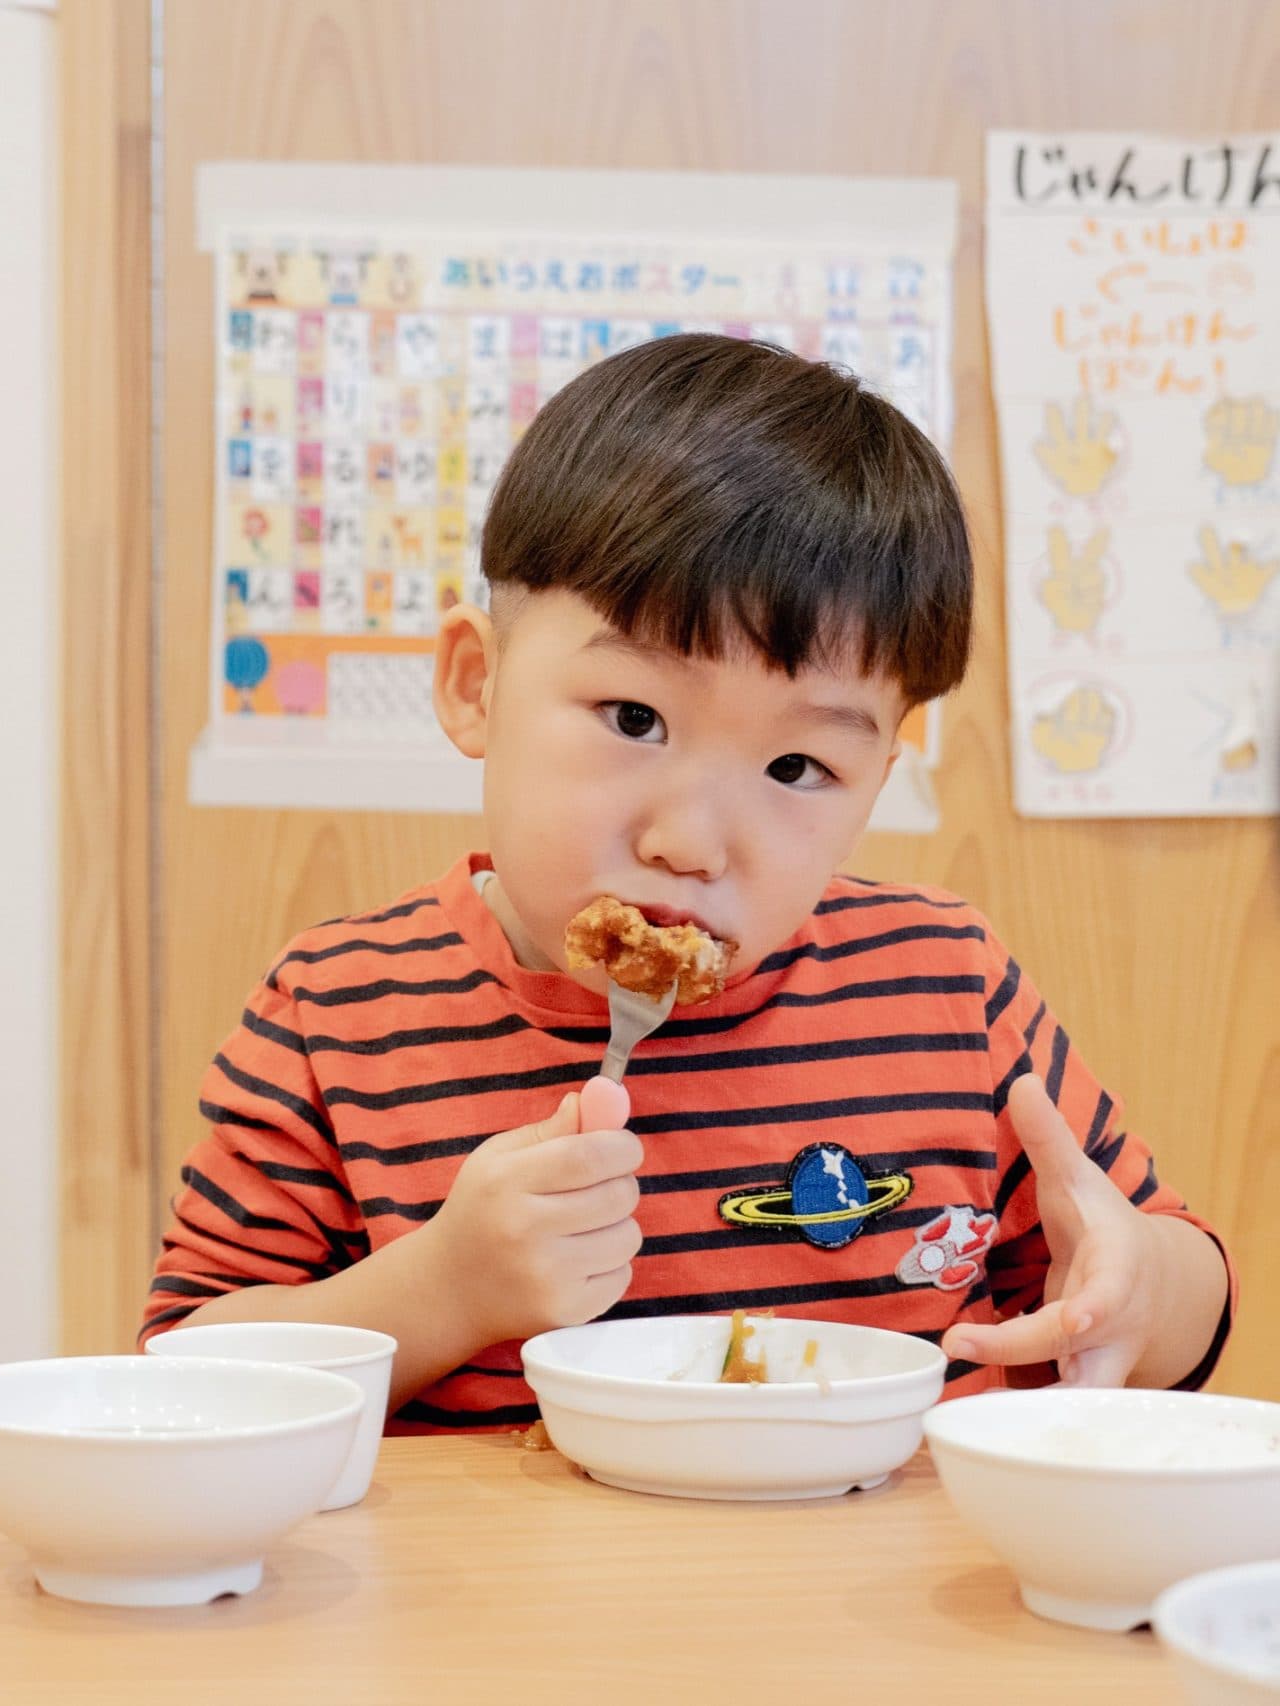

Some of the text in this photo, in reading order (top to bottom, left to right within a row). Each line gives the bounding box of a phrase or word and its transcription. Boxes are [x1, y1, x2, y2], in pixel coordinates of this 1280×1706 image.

[442, 256, 741, 294] あいうえおポスター
[257, 317, 296, 352] わ
[331, 314, 361, 354] ら
[403, 320, 437, 354] や
[472, 324, 497, 358] ま
[1053, 304, 1258, 353] じゃんけん
[332, 381, 359, 420] り
[333, 447, 359, 484] る
[399, 450, 435, 484] ゆ
[328, 514, 364, 544] れ
[331, 574, 354, 608] ろ
[397, 576, 423, 611] よ
